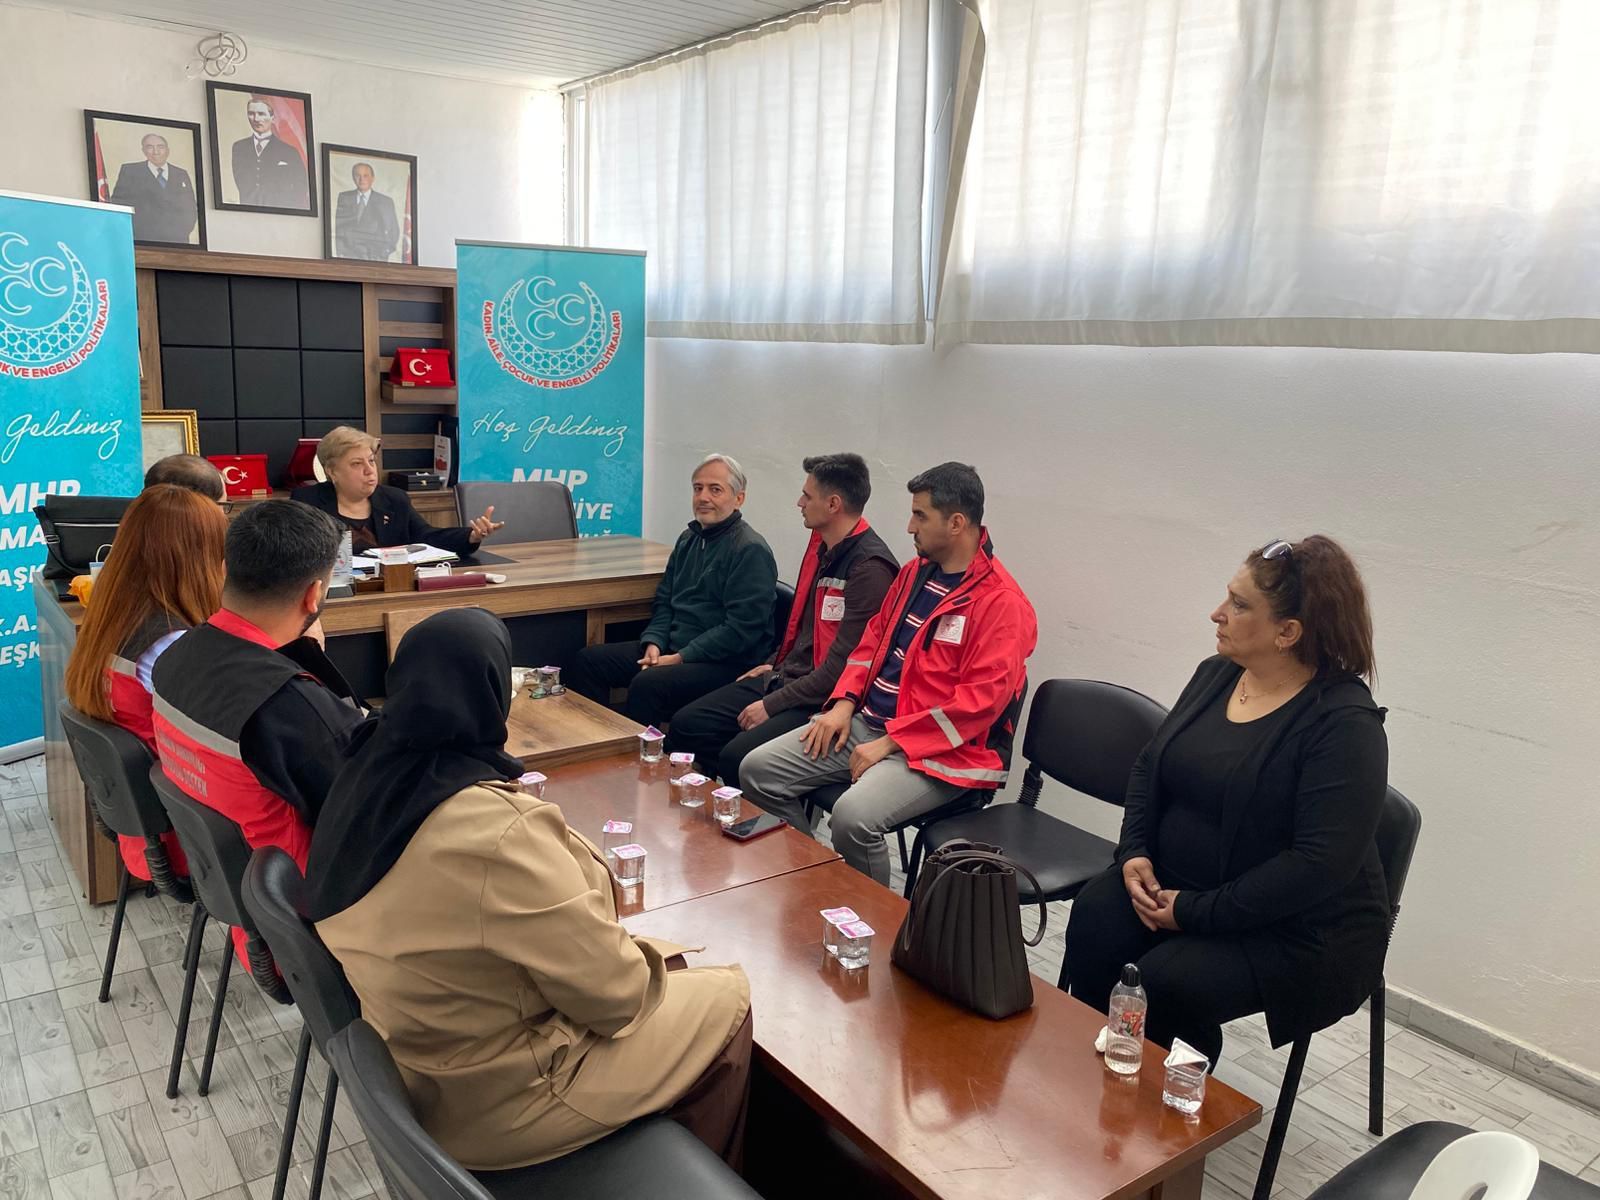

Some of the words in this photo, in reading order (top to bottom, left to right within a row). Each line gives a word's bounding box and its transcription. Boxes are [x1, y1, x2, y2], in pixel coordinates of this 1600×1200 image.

[12, 366, 30, 378] VE
[31, 352, 81, 378] ENGELLİ
[78, 280, 108, 359] POLİTİKALARI
[502, 360, 535, 385] ÇOCUK
[536, 378, 550, 388] VE
[551, 370, 593, 389] ENGELLİ
[591, 312, 621, 375] POLİTİKALARI
[471, 409, 520, 442] Hoş
[572, 498, 614, 520] İYE
